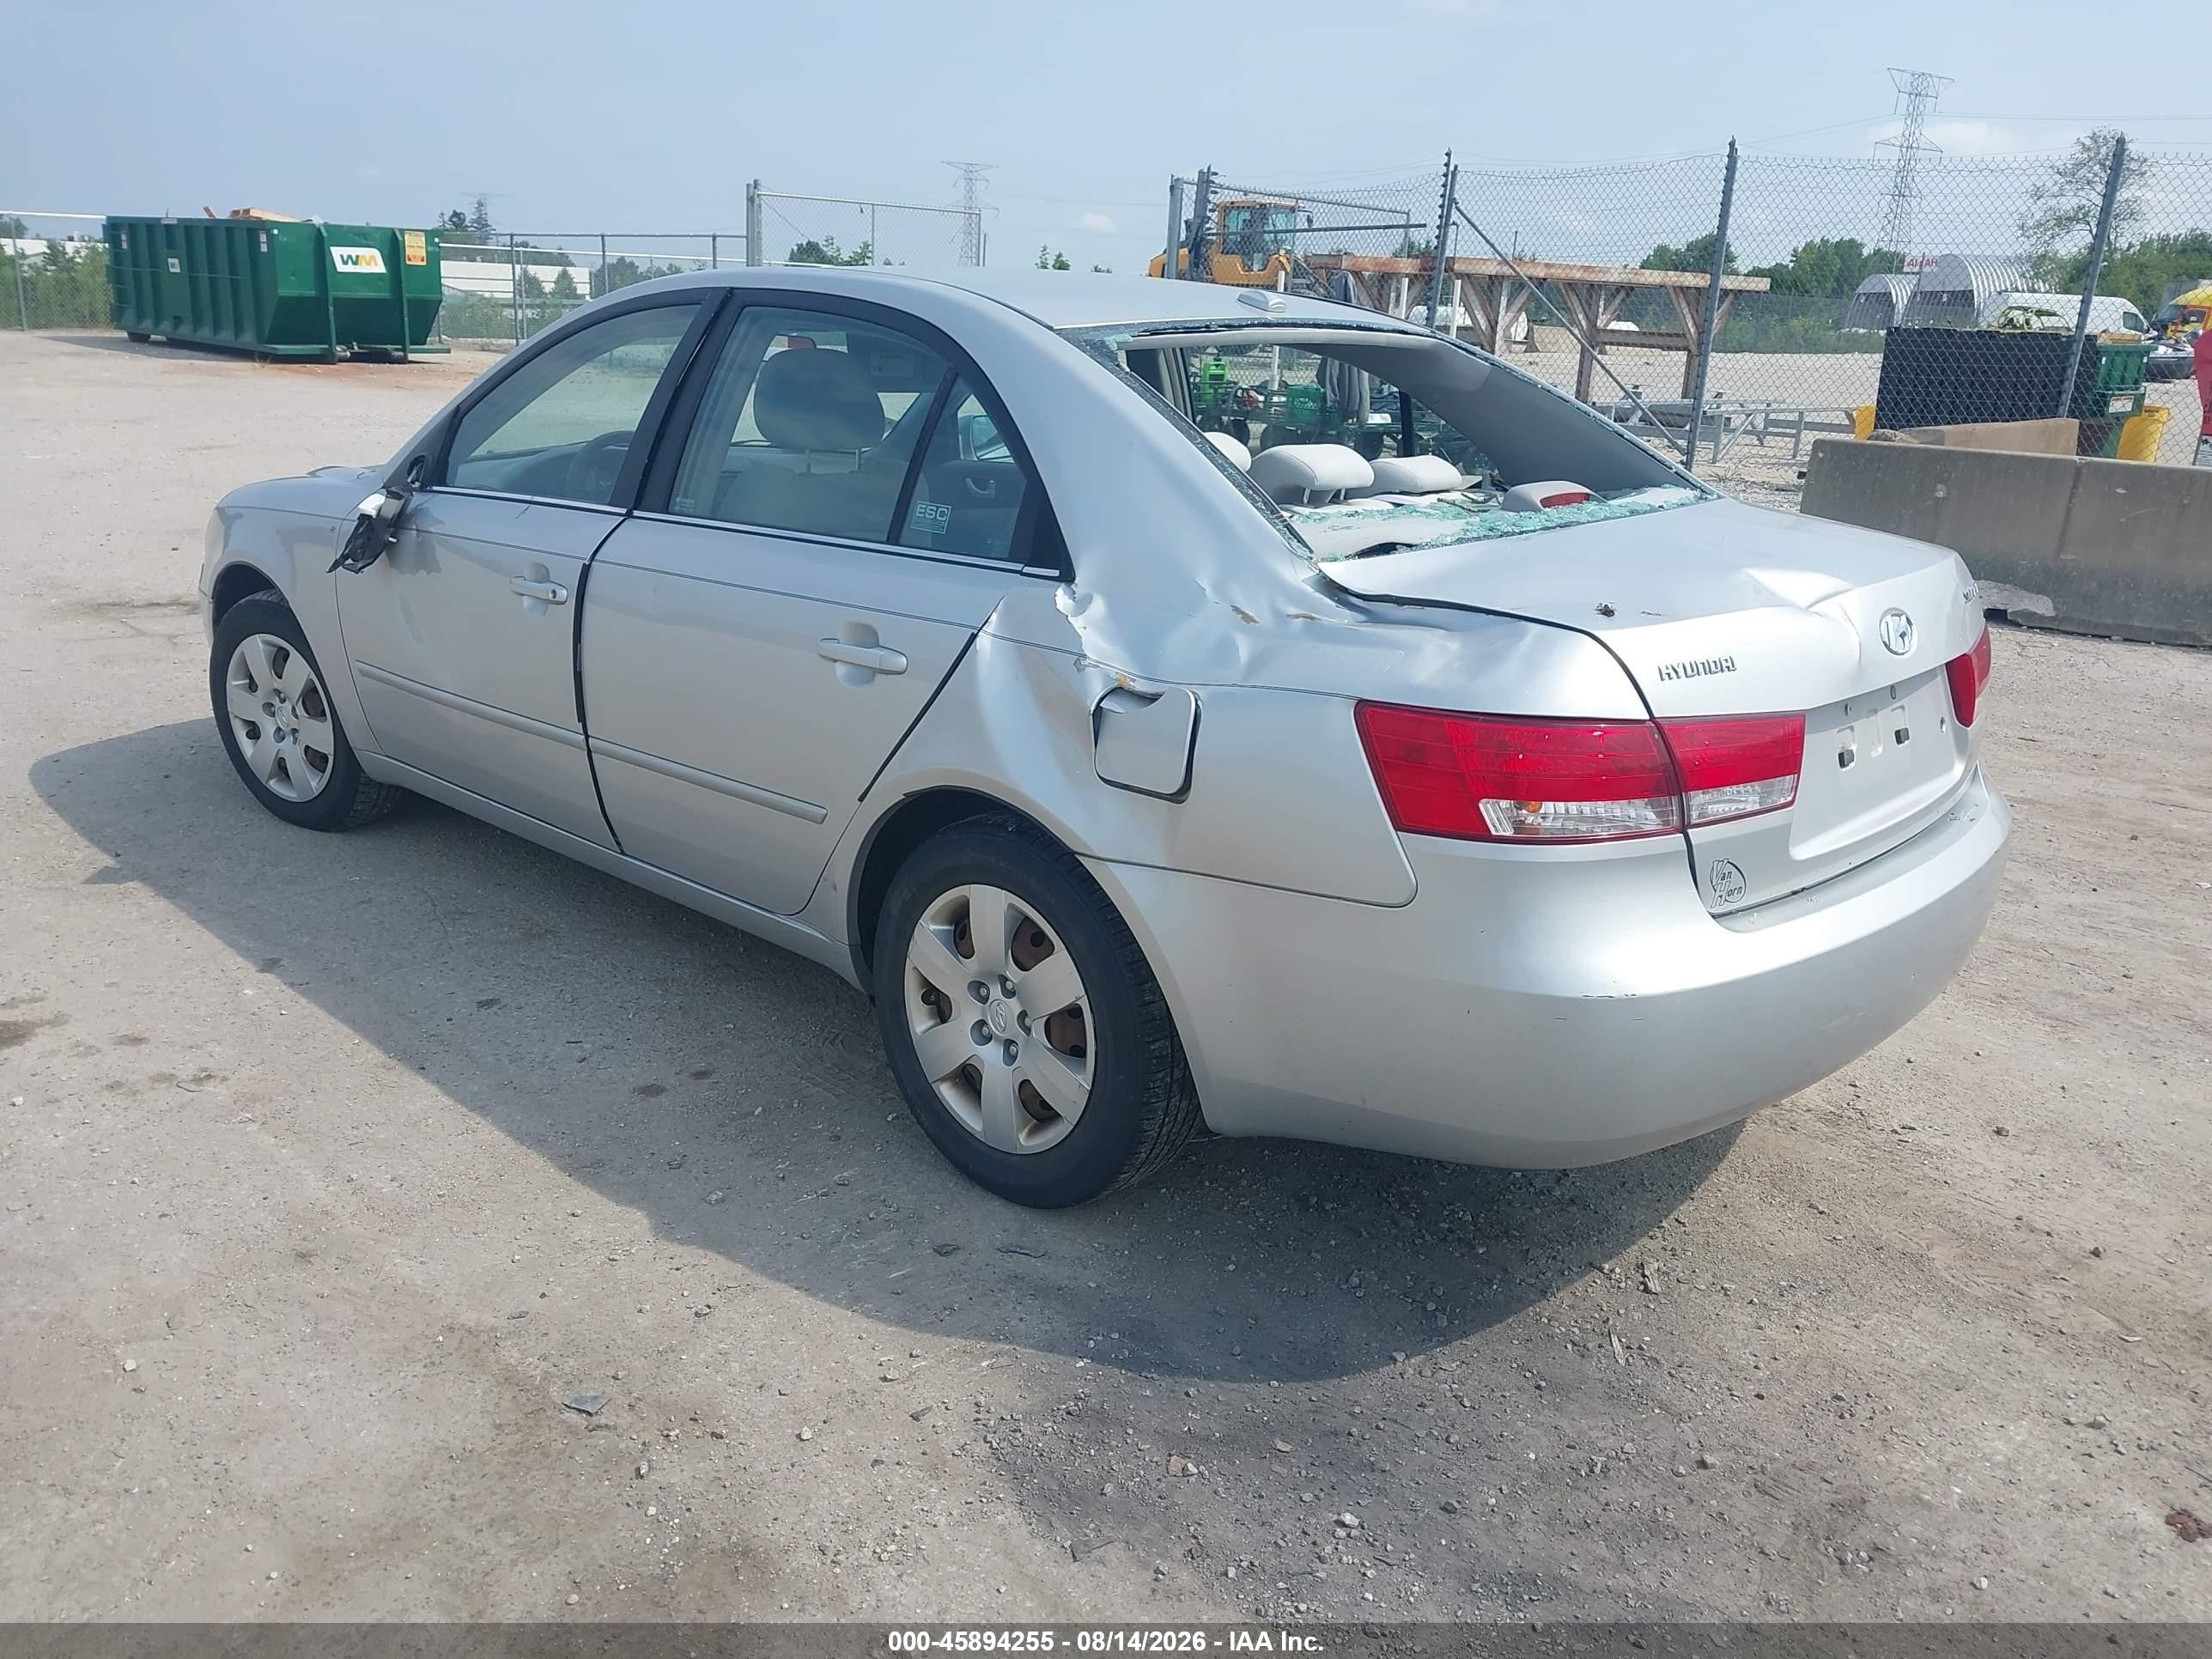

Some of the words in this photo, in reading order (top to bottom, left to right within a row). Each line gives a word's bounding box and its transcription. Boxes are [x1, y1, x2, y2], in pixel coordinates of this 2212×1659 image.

[339, 253, 379, 266] WM
[915, 504, 948, 521] ESC
[1657, 655, 1737, 682] HYUNDAI
[1711, 858, 1733, 886] Van
[1710, 879, 1743, 908] Horn
